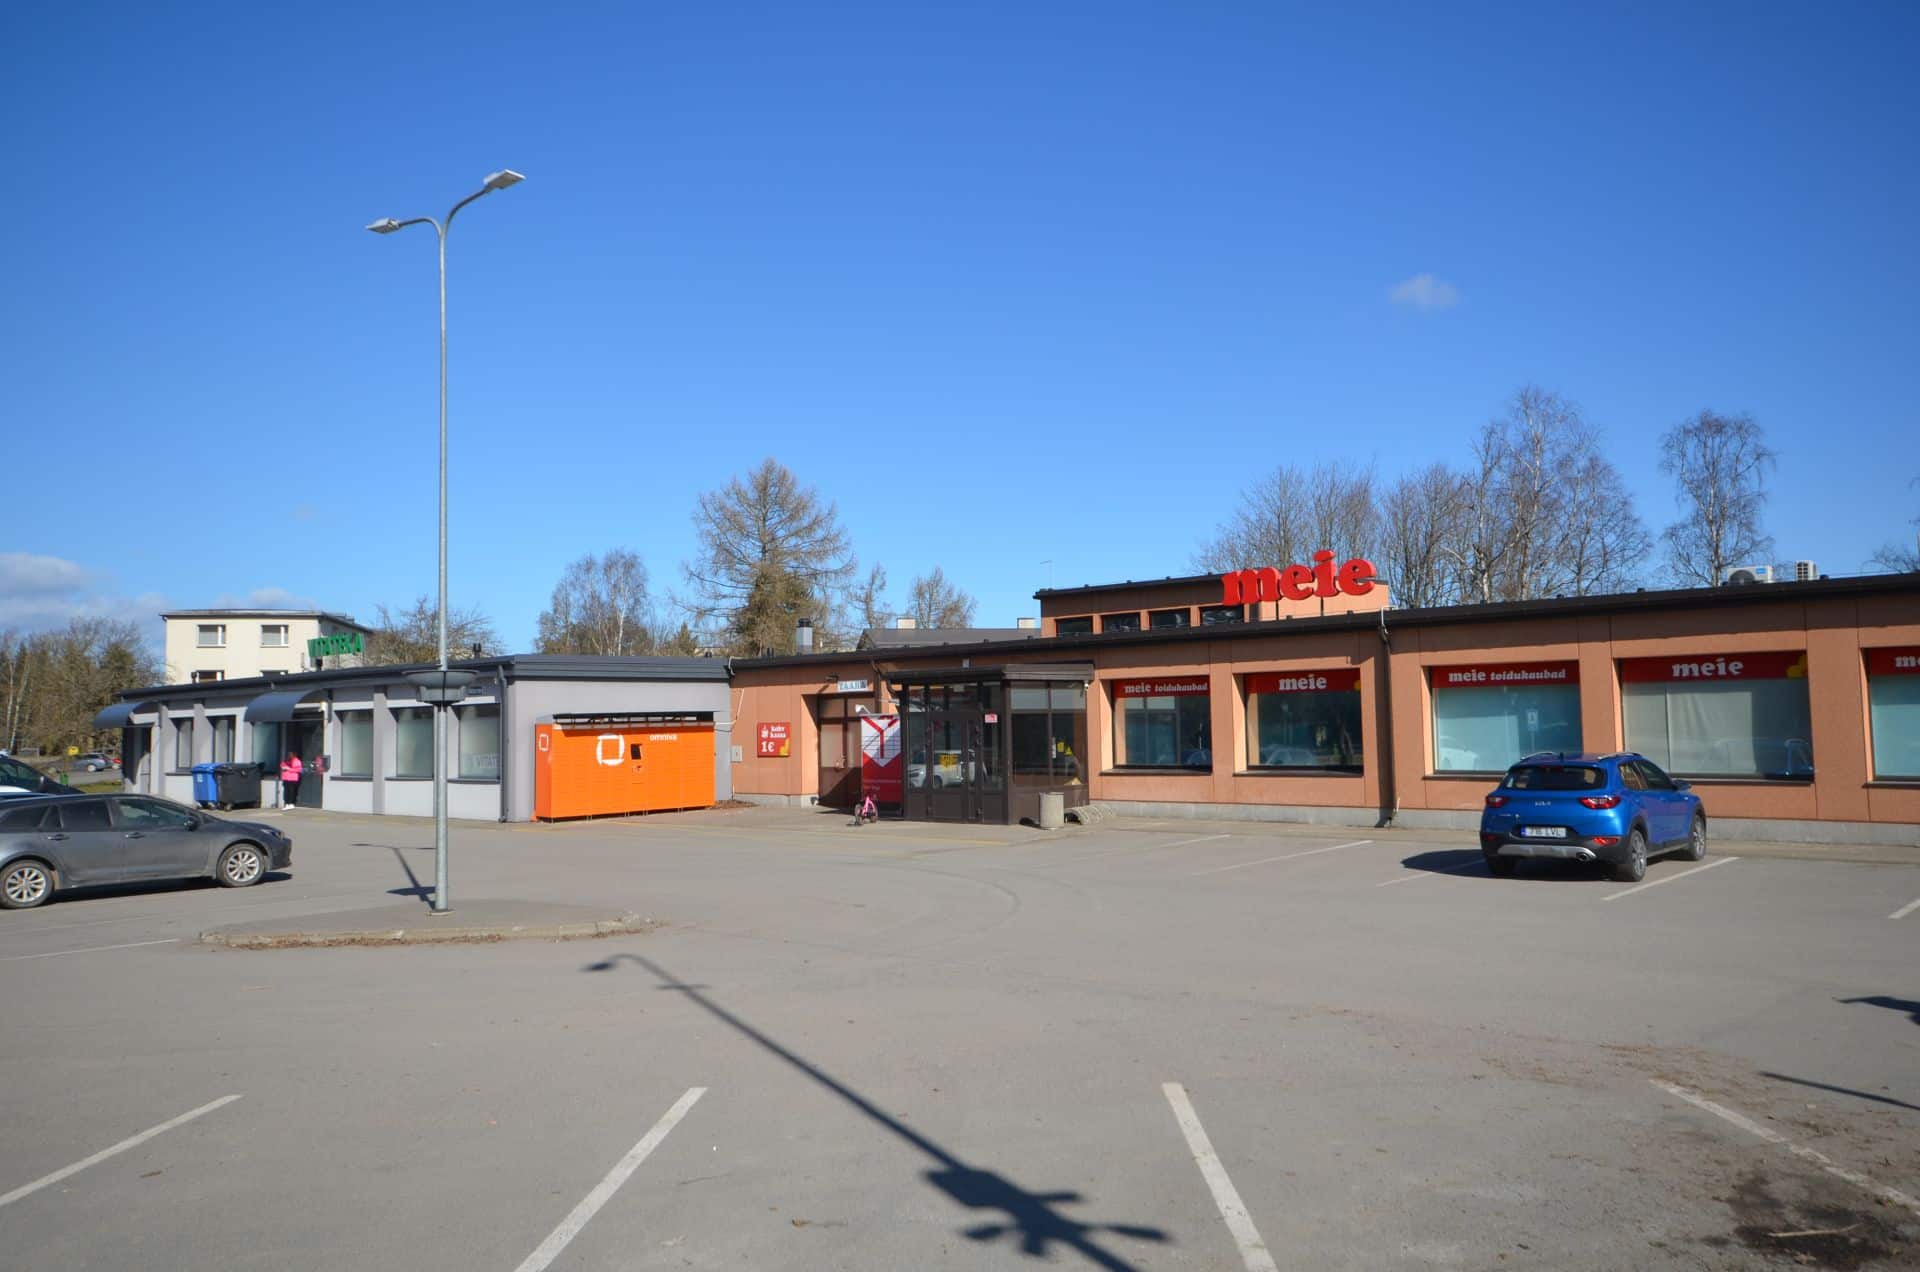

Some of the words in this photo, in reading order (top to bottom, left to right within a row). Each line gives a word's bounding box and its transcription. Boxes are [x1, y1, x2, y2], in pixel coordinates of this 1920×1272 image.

[1222, 550, 1377, 606] meie
[1671, 657, 1744, 677] meie
[1278, 673, 1328, 691] meie
[1448, 669, 1486, 682] meie
[1490, 669, 1566, 681] toidukaubad
[1124, 682, 1151, 694] meie
[1154, 682, 1208, 693] toidukaubad
[761, 741, 775, 752] 1€
